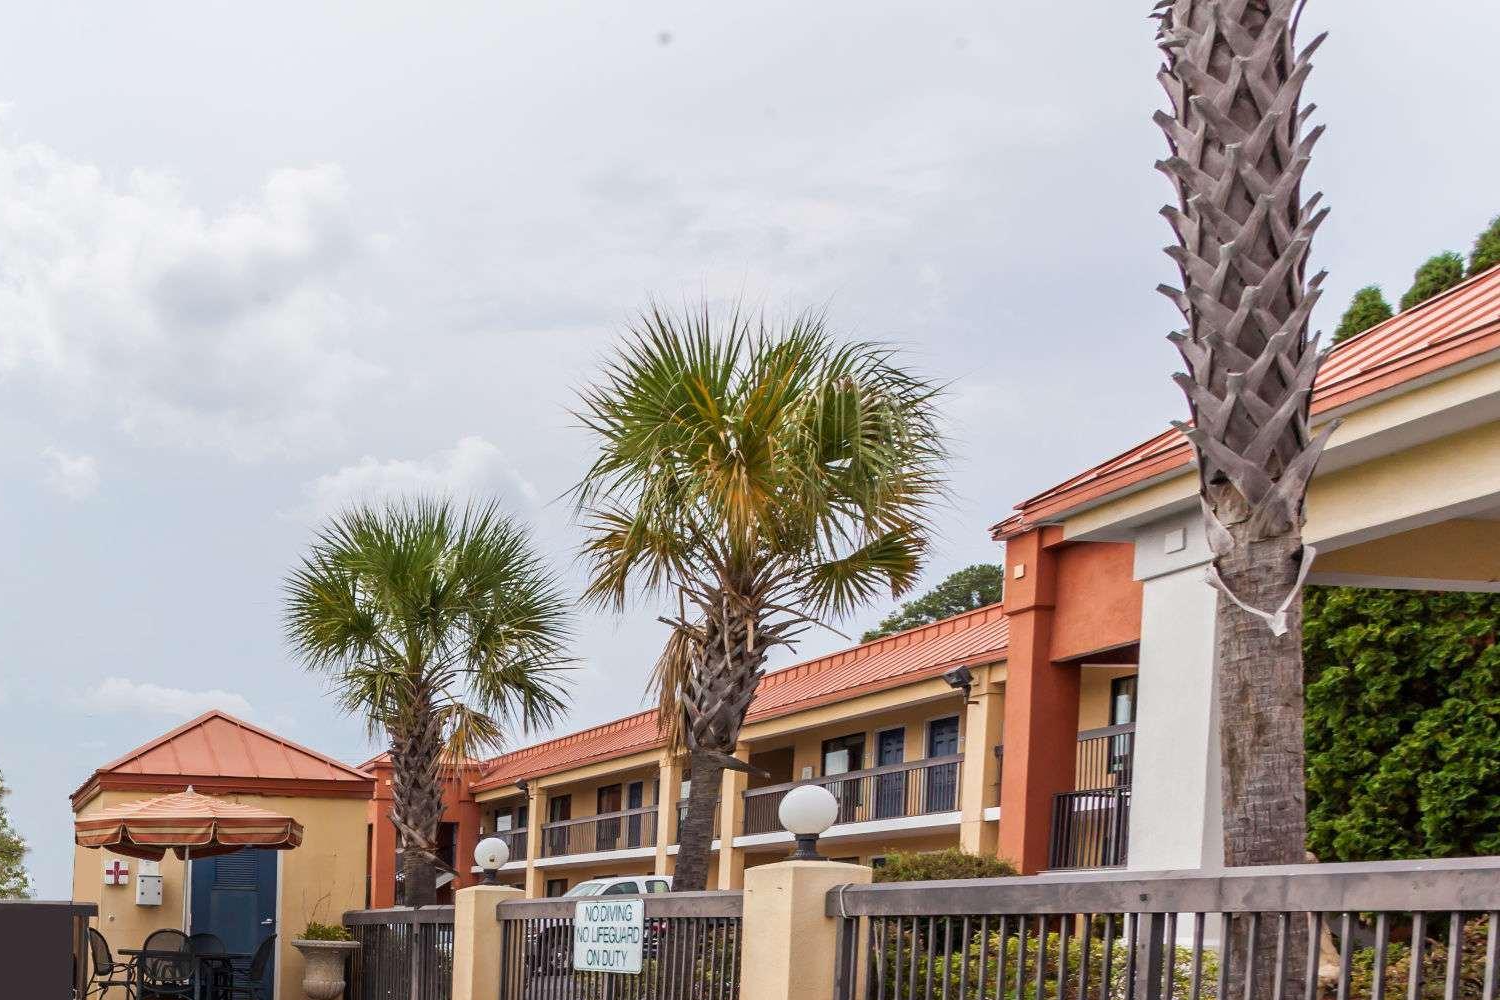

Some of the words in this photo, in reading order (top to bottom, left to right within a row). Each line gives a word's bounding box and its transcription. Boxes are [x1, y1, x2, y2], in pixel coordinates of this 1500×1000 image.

[585, 905, 599, 921] NO
[600, 904, 632, 921] DIVING
[577, 927, 589, 942] NO
[591, 926, 639, 943] LIFEGUARD
[586, 949, 600, 966] ON
[602, 950, 627, 967] DUTY
